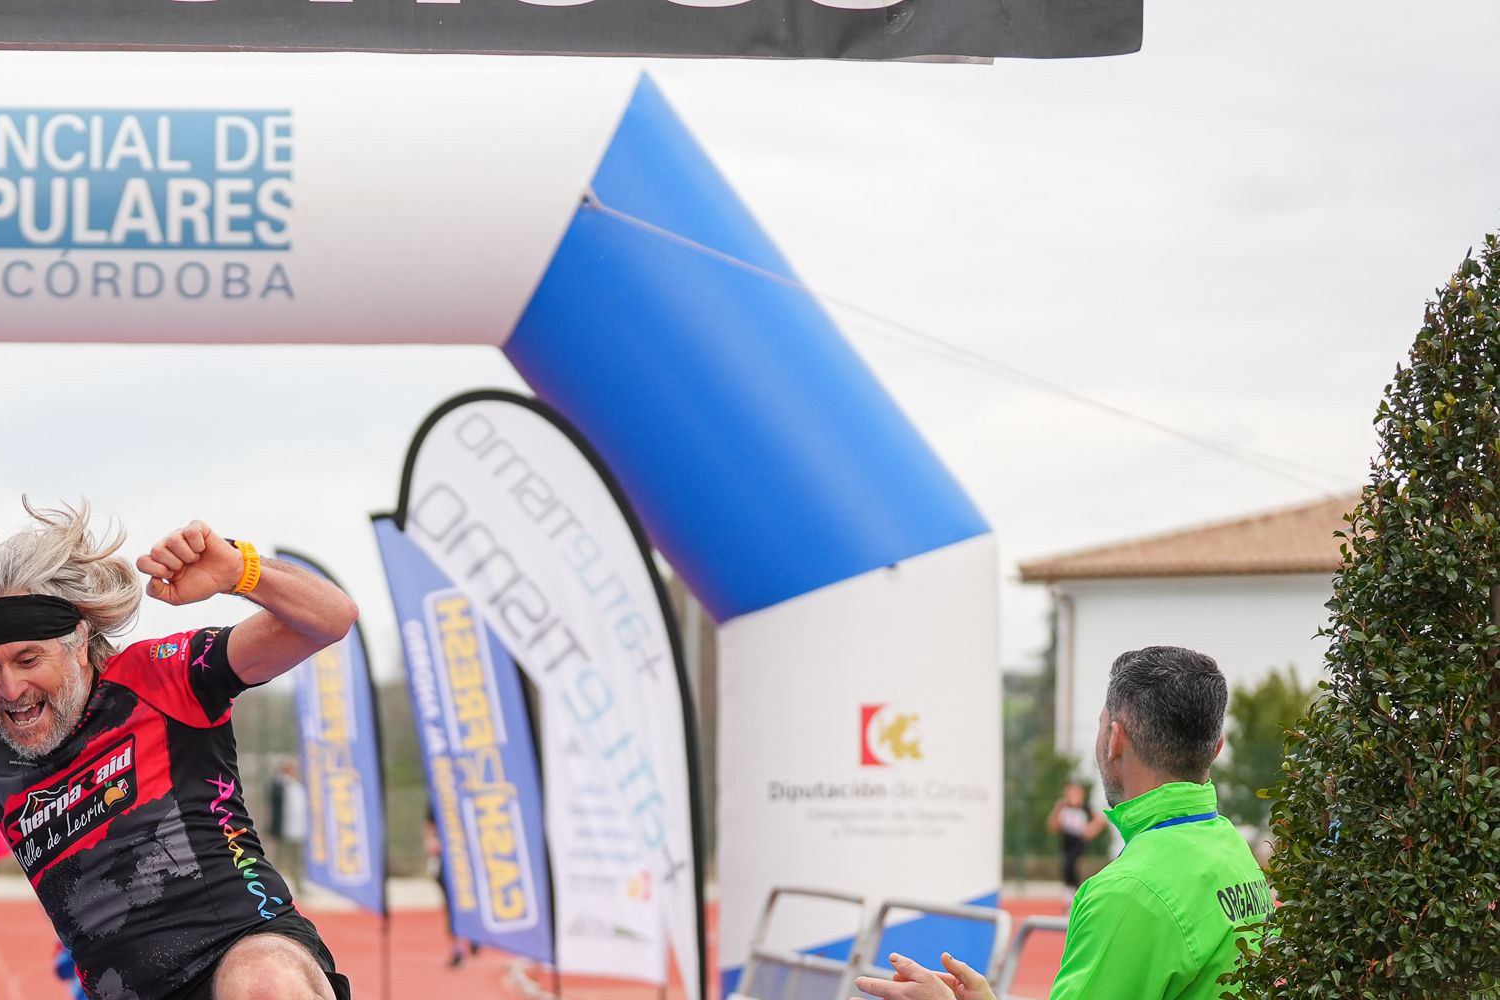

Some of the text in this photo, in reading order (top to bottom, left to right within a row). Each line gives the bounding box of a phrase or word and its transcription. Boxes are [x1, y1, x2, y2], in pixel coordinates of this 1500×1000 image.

[217, 117, 294, 174] DE
[1, 250, 297, 300] CÓRDOBA
[47, 827, 62, 850] de
